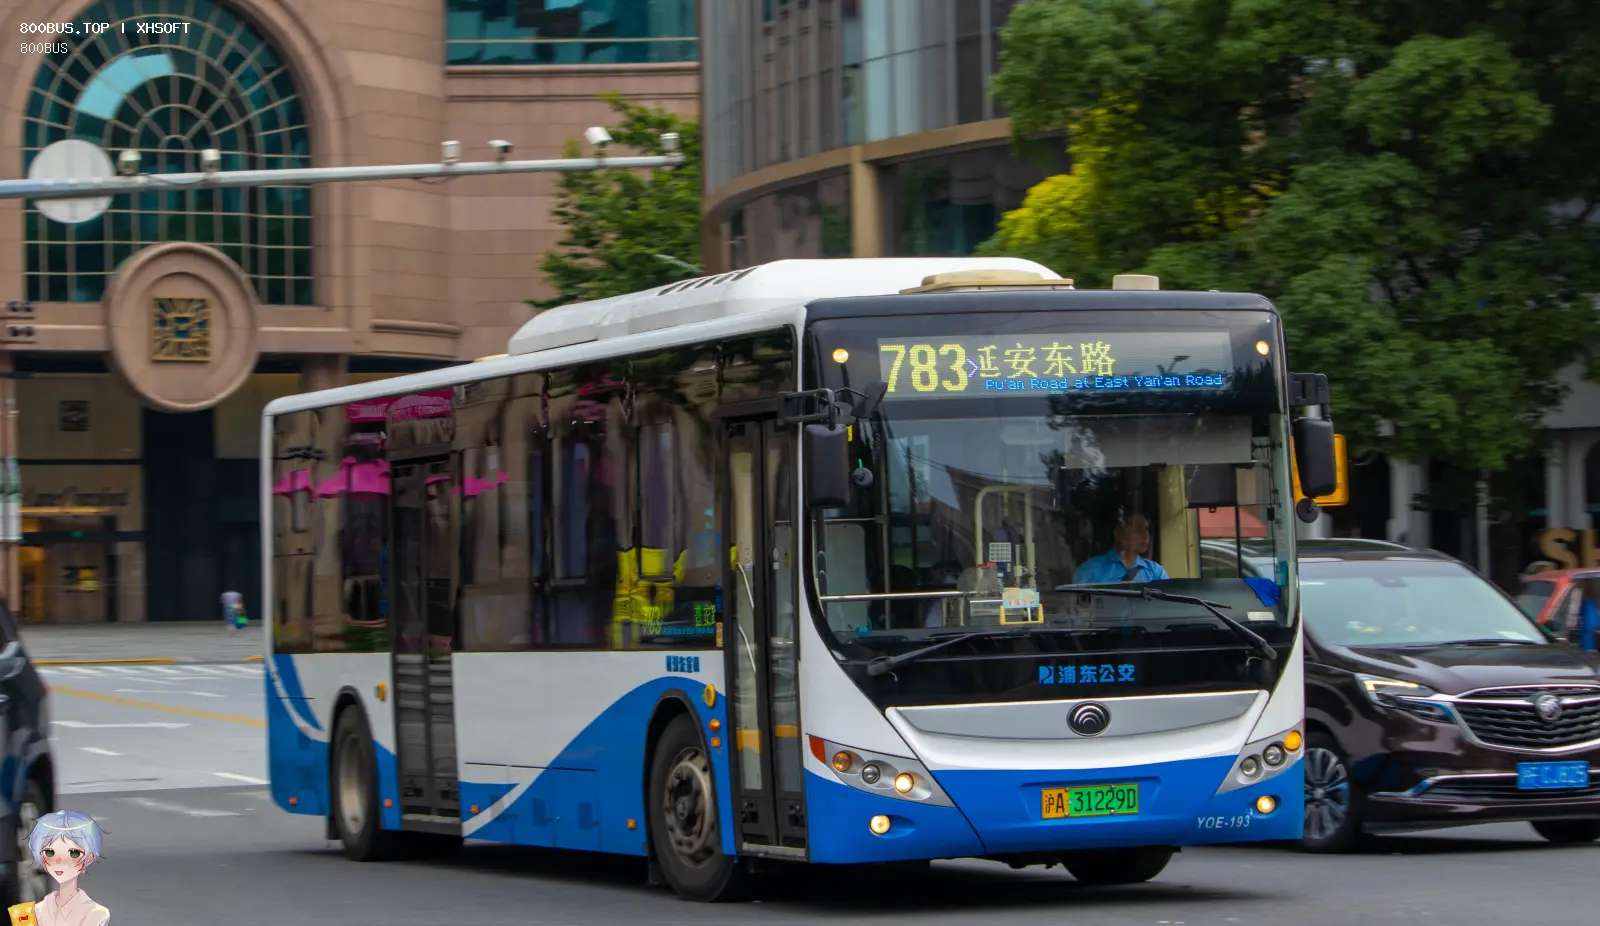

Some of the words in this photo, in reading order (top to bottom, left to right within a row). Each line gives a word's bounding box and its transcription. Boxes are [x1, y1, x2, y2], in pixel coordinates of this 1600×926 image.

[880, 343, 968, 392] 783
[977, 341, 1117, 378] 延安东路
[984, 377, 1025, 391] Pu'an
[1030, 376, 1068, 390] Road
[1073, 376, 1090, 389] at
[1094, 376, 1129, 388] East
[1133, 375, 1181, 388] Yan'an
[1185, 373, 1224, 387] Road
[1058, 663, 1136, 684] 浦东公交
[1044, 791, 1066, 814] 沪A
[1073, 787, 1137, 813] 31229D
[1197, 814, 1250, 829] YOE-193
